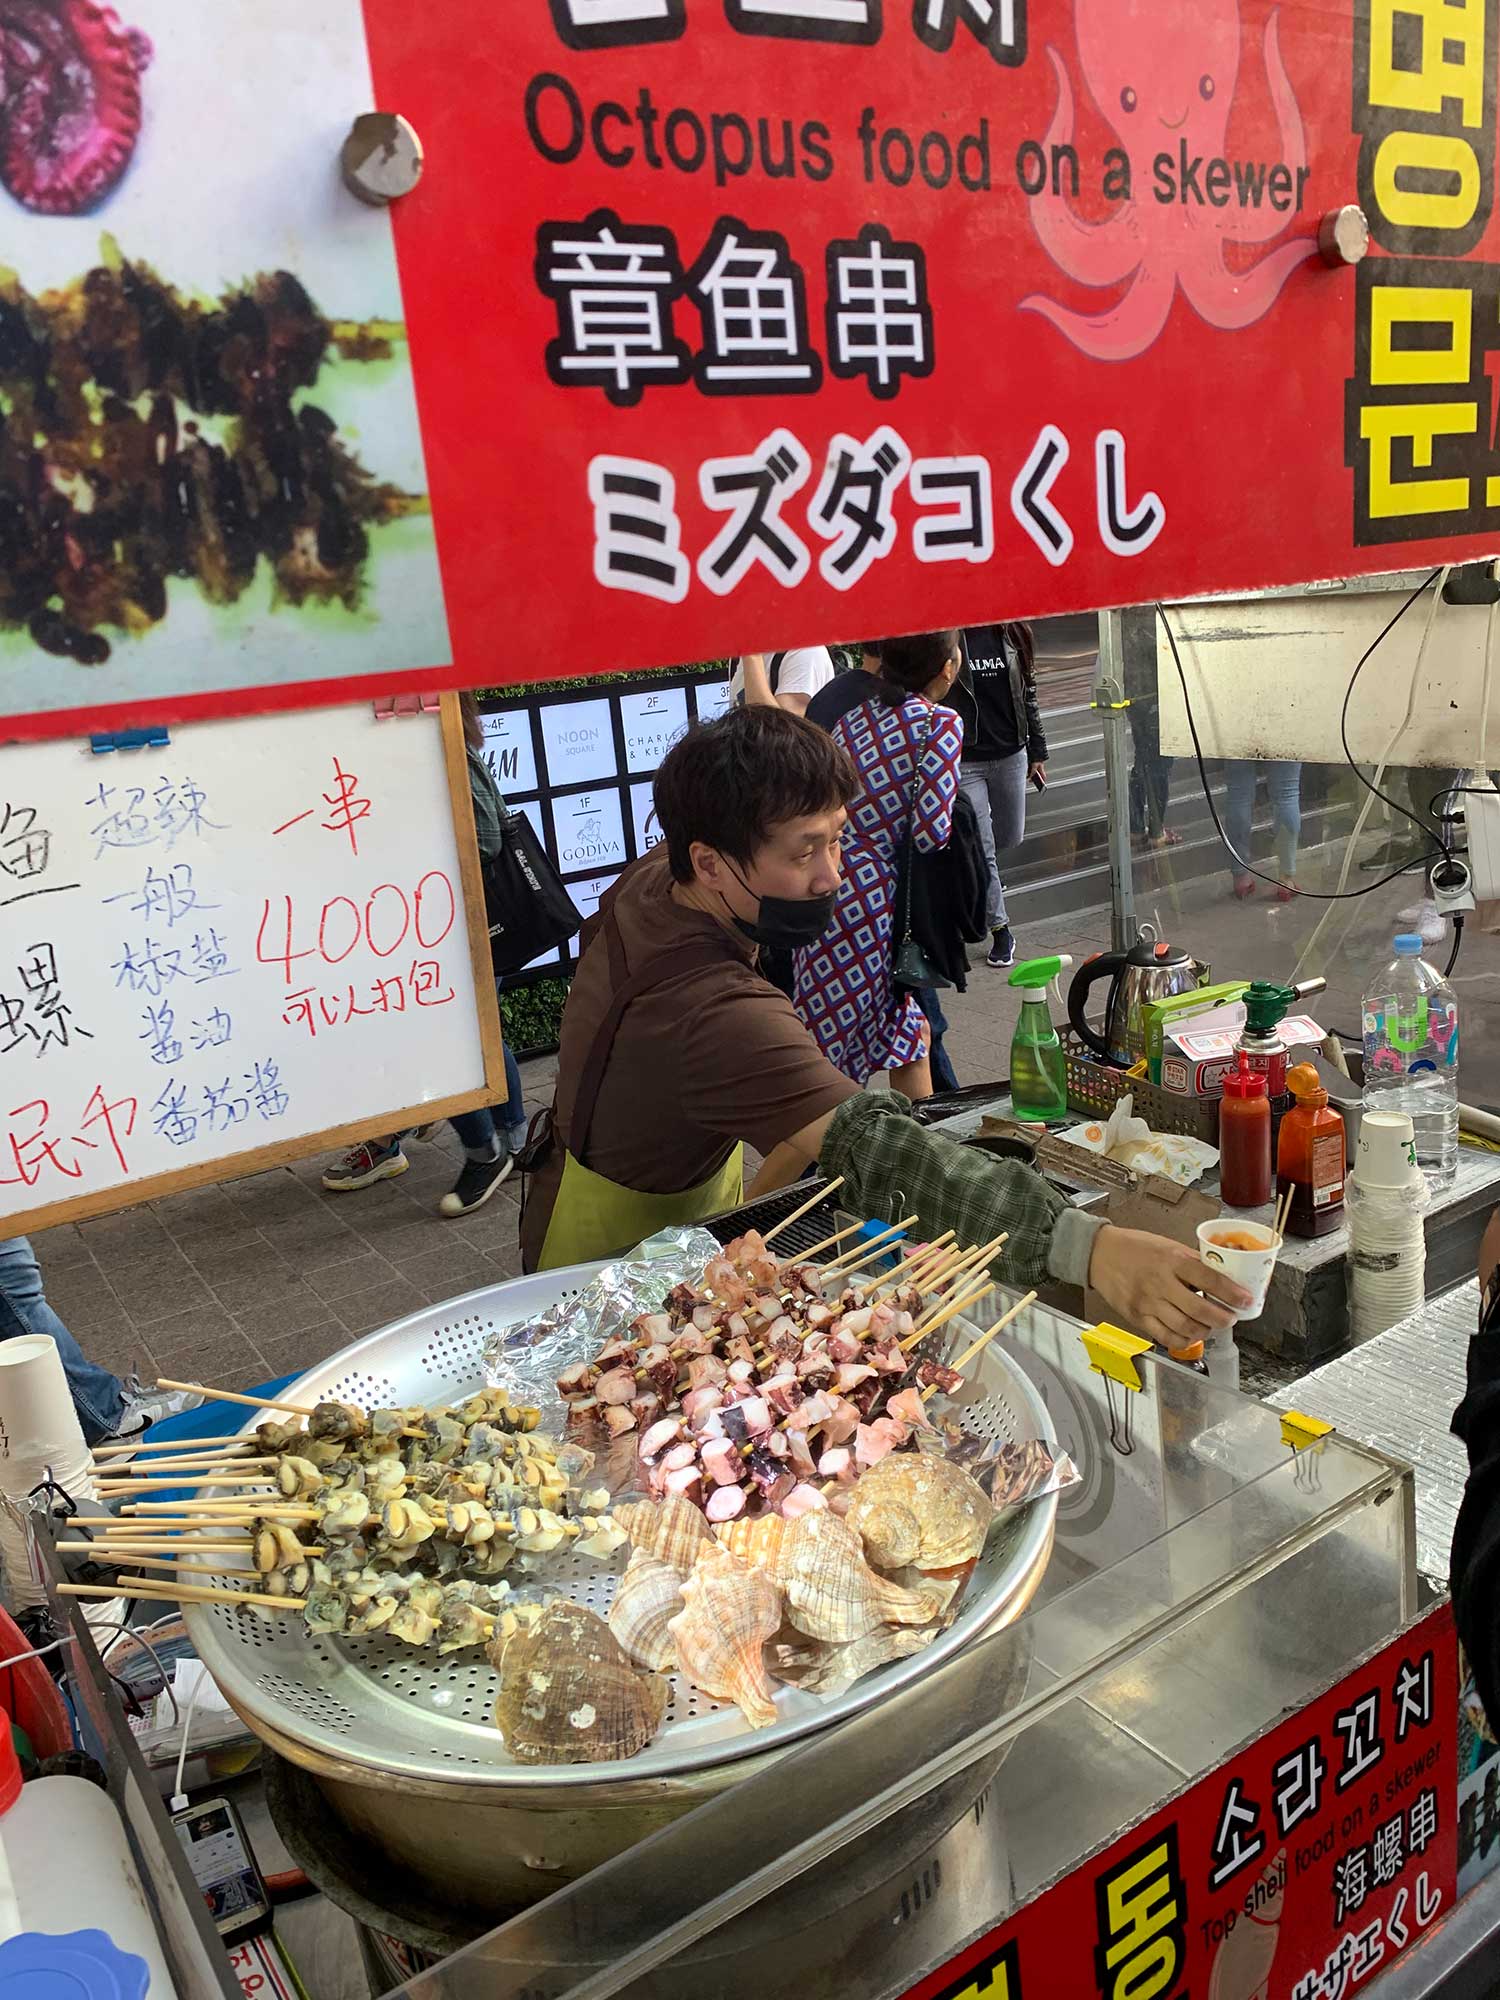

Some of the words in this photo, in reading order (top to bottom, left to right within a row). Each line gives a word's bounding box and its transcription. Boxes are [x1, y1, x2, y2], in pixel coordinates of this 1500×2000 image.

[524, 72, 834, 187] Octopus
[857, 106, 992, 191] food
[1016, 139, 1081, 199] on
[1102, 147, 1132, 201] a
[1152, 139, 1311, 213] skewer
[540, 212, 931, 402] 章鱼串
[587, 425, 1165, 602] ミズダコくし
[646, 696, 659, 708] 2F
[969, 657, 1005, 671] ALMA
[557, 727, 600, 745] NOON
[565, 744, 596, 756] SQUARE
[84, 775, 233, 861] 超辣
[272, 756, 372, 857] 一串
[580, 797, 591, 808] 1F
[101, 863, 223, 928] 一般
[562, 840, 621, 863] GODIVA
[256, 870, 456, 985] 4000
[282, 959, 456, 1037] 可以打包
[0, 1084, 138, 1186] 民币
[1210, 1657, 1433, 1888] 소라꼬치
[1200, 1909, 1237, 1951] Top
[1243, 1861, 1288, 1918] shell
[1294, 1833, 1336, 1876] food
[1340, 1809, 1364, 1836] on
[1368, 1792, 1381, 1815] a
[1384, 1742, 1443, 1800] skewer
[1334, 1790, 1438, 1924] 海螺串
